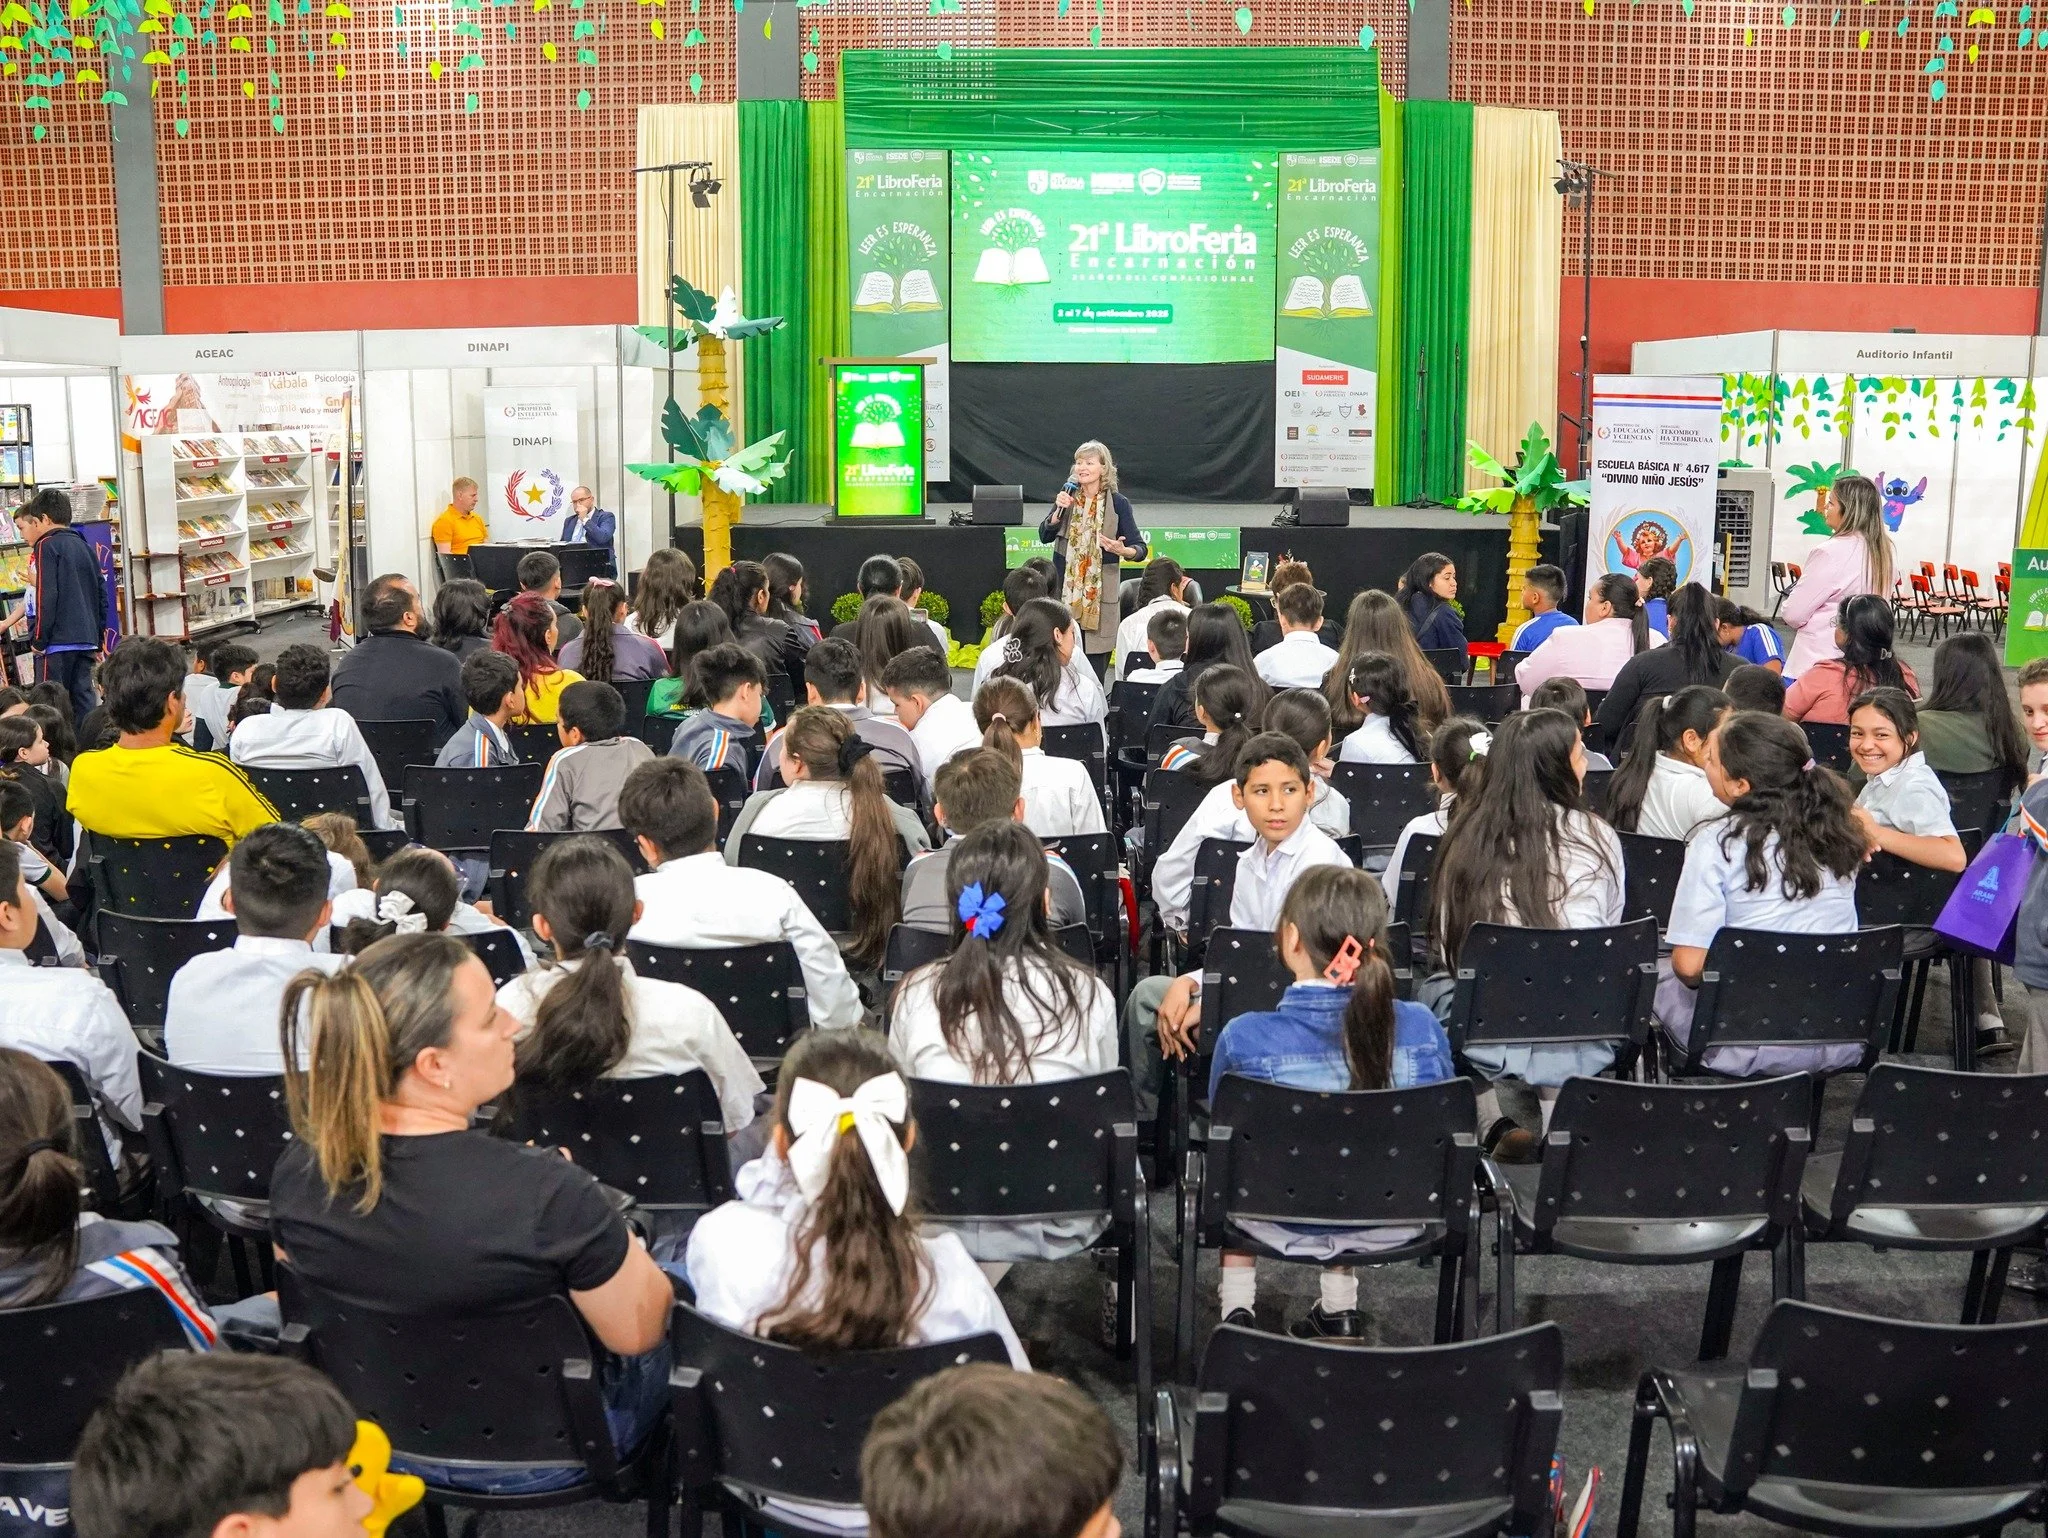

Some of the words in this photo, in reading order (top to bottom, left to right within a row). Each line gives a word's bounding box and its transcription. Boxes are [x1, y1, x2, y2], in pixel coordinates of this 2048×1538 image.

[856, 174, 875, 189] 21ª
[877, 173, 943, 189] LibroFeria
[1287, 177, 1307, 192] 21ª
[1309, 178, 1377, 193] LibroFeria
[855, 189, 943, 198] Encarnación
[1287, 193, 1377, 201] Encarnación
[858, 234, 879, 256] LEER
[876, 224, 889, 239] ES
[892, 221, 938, 258] ESPERANZA
[1068, 221, 1109, 252] 21ª
[1115, 222, 1258, 254] LibroFeria
[1288, 237, 1309, 259] LEER
[1306, 228, 1321, 242] ES
[1324, 226, 1370, 263] ESPERANZA
[1070, 252, 1256, 270] Encarnación
[1152, 274, 1218, 283] COMPLEJO
[1221, 275, 1255, 283] UNAE
[195, 349, 234, 358] AGEAC
[468, 343, 509, 352] DINAPI
[1856, 349, 1909, 359] Auditorio
[1912, 350, 1953, 360] Infantil
[268, 376, 308, 390] Kábala
[513, 437, 552, 446] DINAPI
[1672, 435, 1714, 443] TEMBIKUAA
[1597, 459, 1635, 470] ESCUELA
[1638, 459, 1670, 472] BÁSICA
[1685, 464, 1710, 474] 4.617
[1641, 473, 1665, 486] NIÑO
